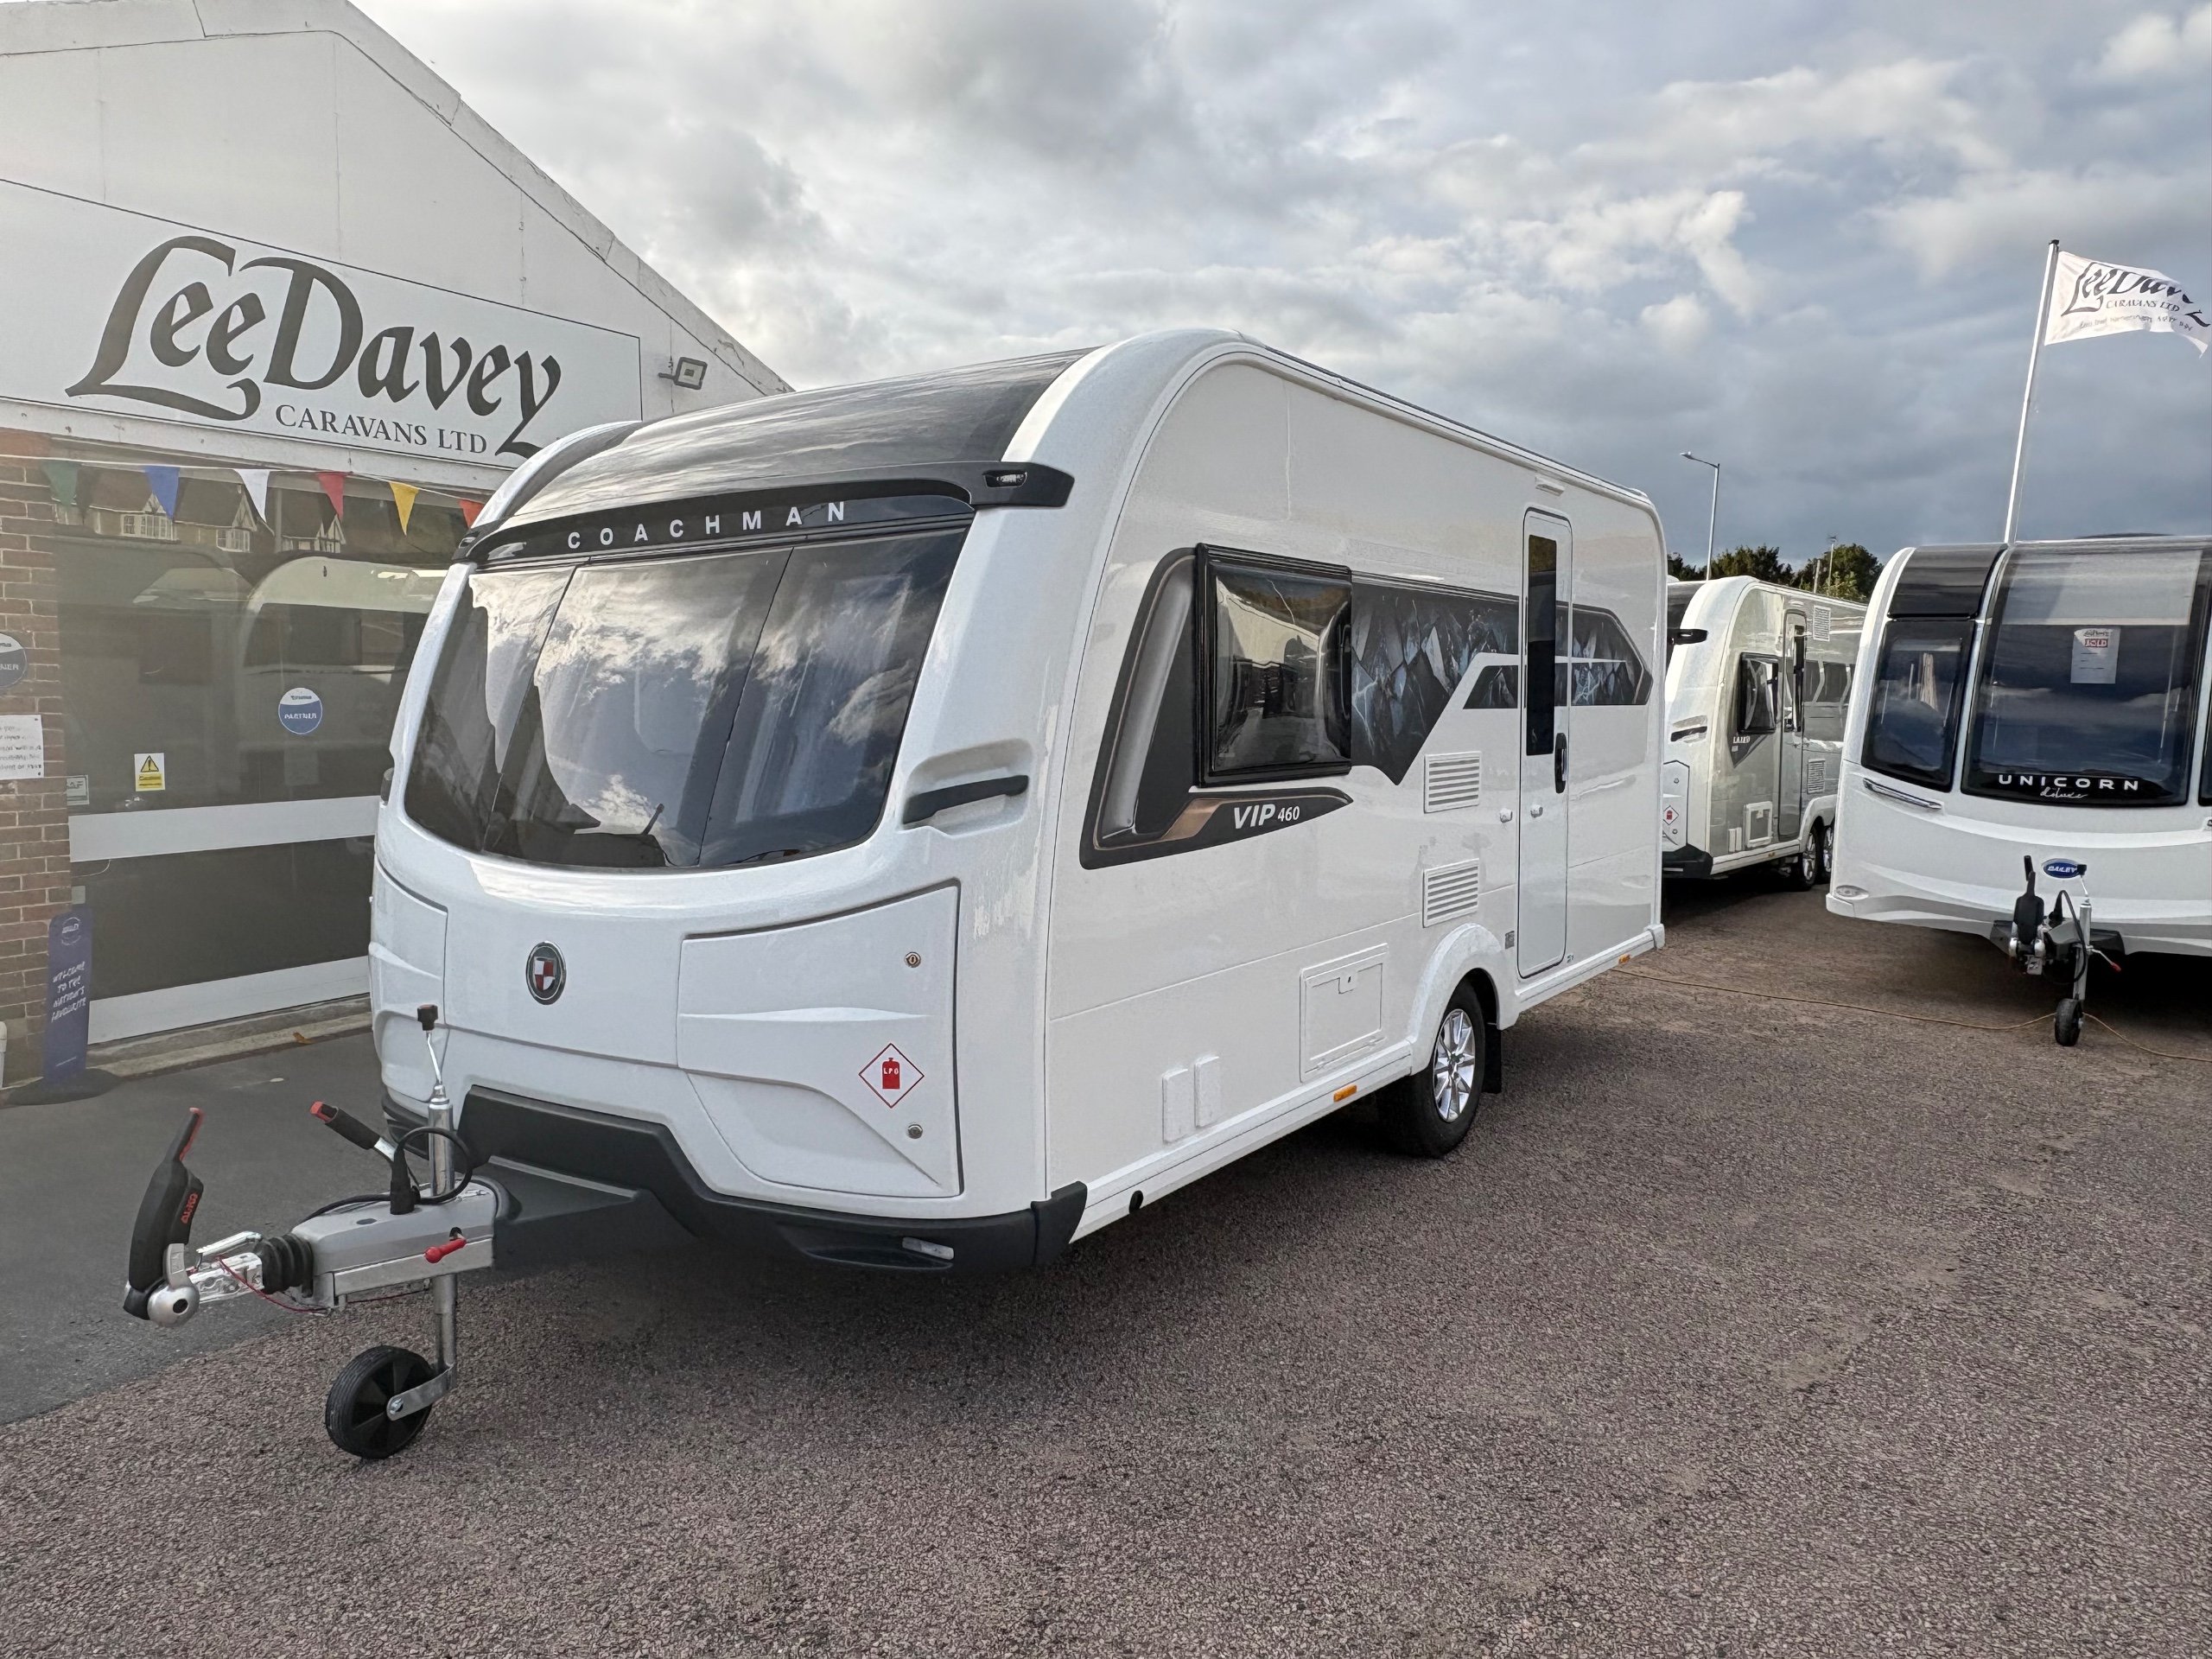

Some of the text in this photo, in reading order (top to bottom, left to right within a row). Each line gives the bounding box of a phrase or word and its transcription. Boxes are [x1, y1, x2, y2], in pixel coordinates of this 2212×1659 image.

[276, 404, 487, 454] CARAVANS LTD
[568, 501, 844, 550] COACHMAN
[1998, 774, 2139, 791] UNICORN
[1234, 804, 1300, 830] VIP 460
